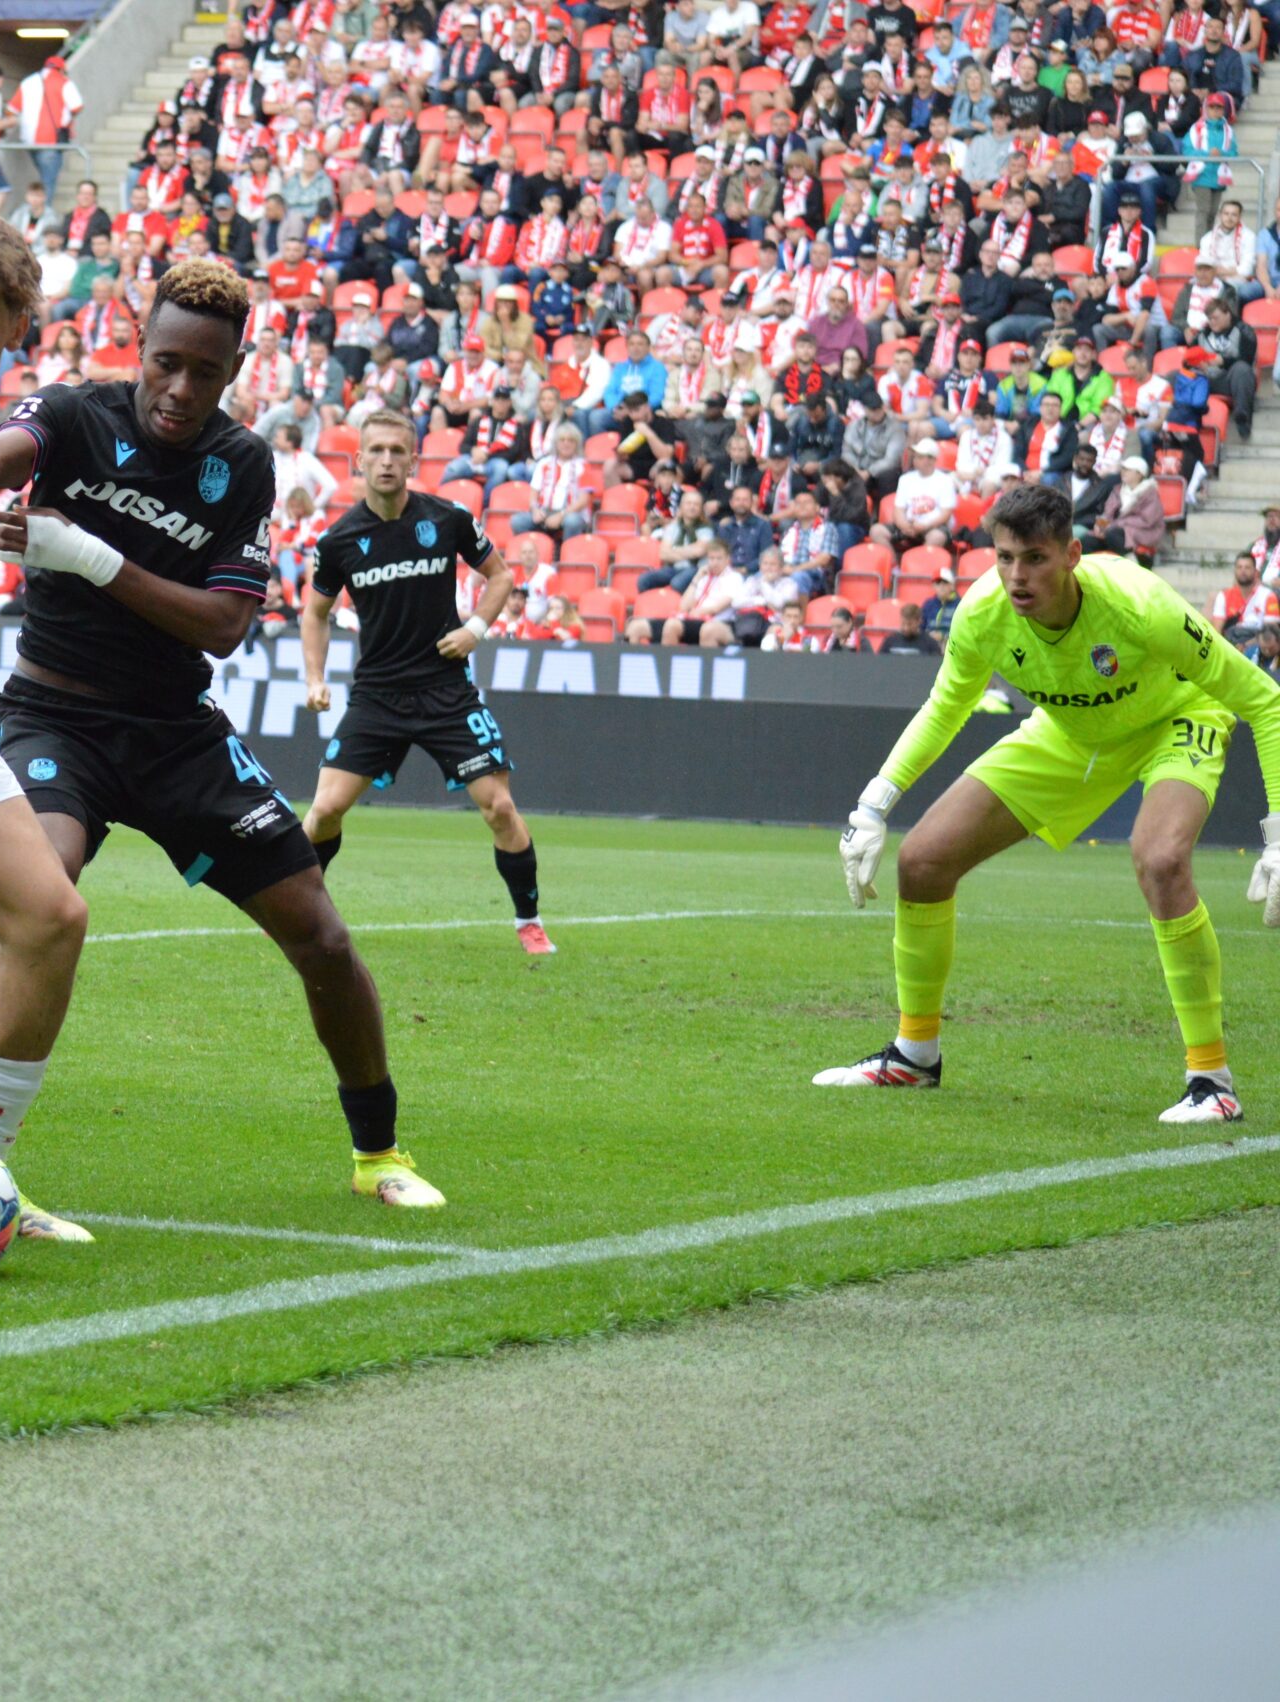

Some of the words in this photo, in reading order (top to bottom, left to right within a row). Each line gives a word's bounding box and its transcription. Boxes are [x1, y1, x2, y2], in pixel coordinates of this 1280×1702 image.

[352, 557, 449, 589] DOOSAN
[467, 709, 503, 746] 99
[1172, 717, 1217, 757] 30
